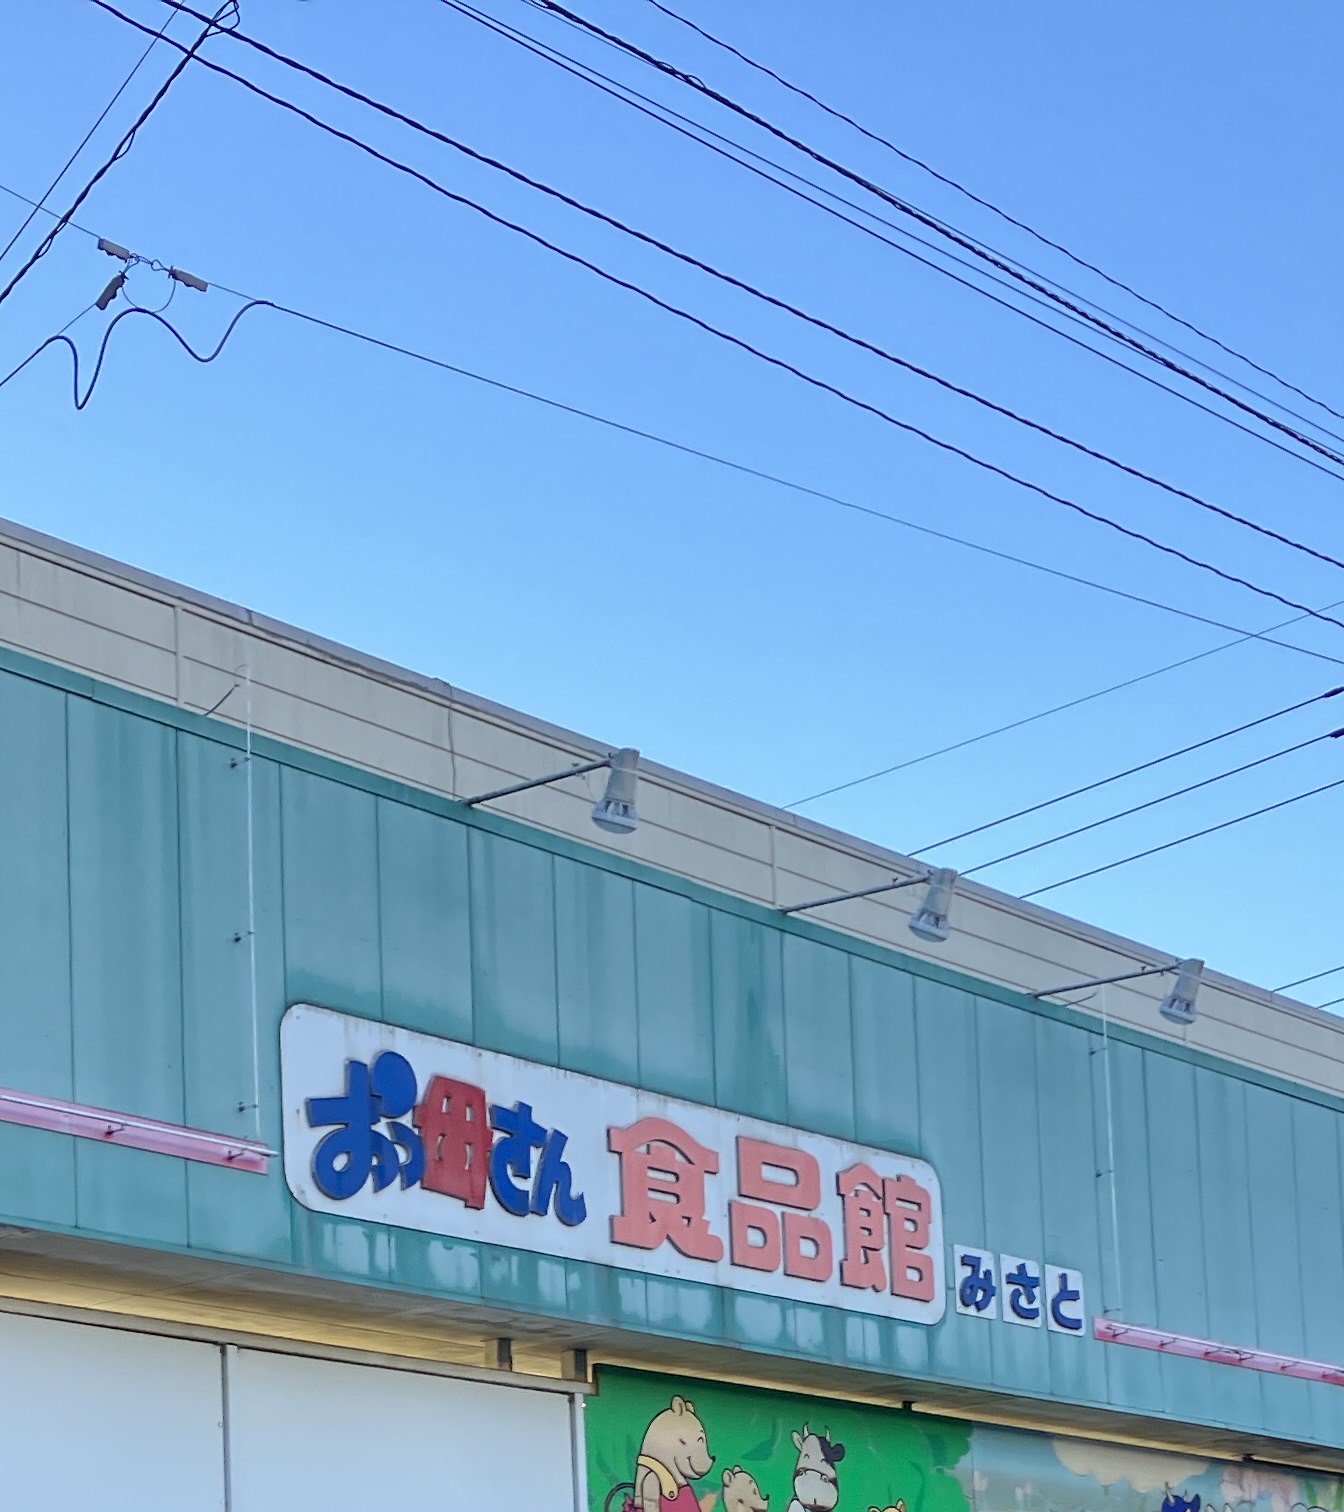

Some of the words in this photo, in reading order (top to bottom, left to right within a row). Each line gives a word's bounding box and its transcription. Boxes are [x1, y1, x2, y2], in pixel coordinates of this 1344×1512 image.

[308, 1050, 587, 1227] お母さん
[608, 1117, 936, 1302] 食品館
[959, 1254, 1083, 1331] みさと
